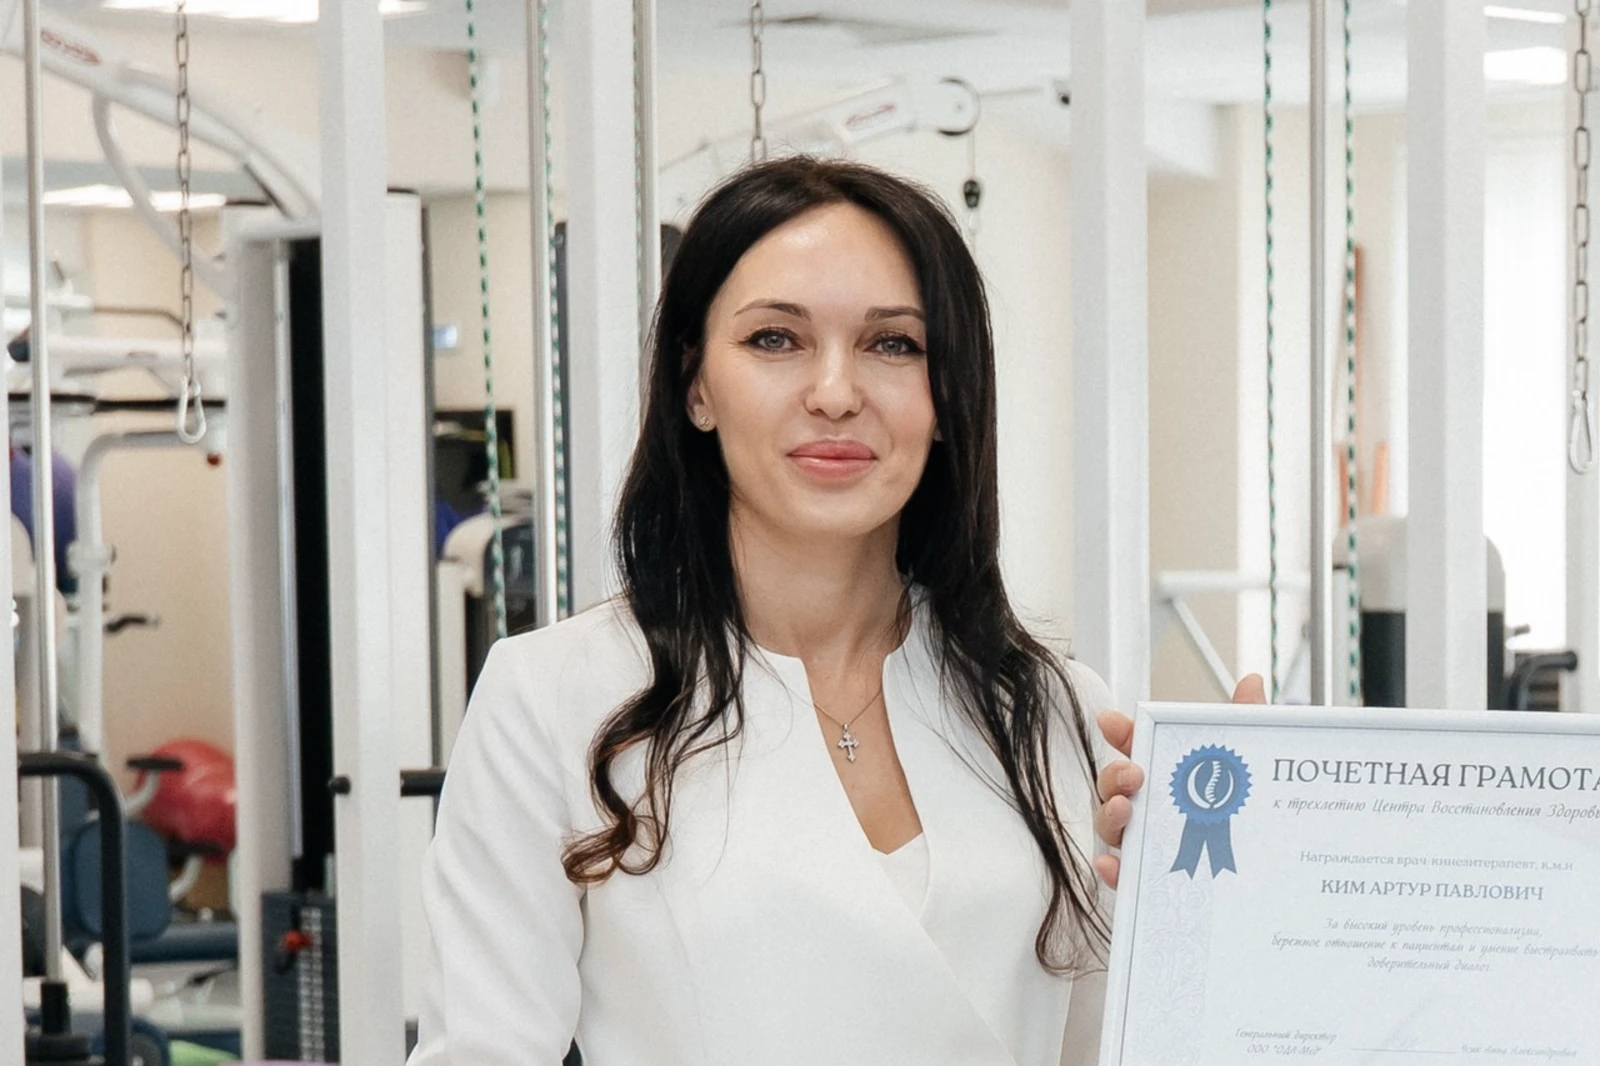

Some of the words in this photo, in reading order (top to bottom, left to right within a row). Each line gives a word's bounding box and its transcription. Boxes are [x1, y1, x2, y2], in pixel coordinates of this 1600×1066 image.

[1272, 758, 1451, 787] ПОЧЕТНАЯ
[1273, 799, 1281, 810] к
[1287, 798, 1366, 815] трехлетию
[1372, 799, 1425, 818] Центра
[1431, 801, 1541, 818] Восстановления
[1300, 851, 1394, 866] Награждается
[1320, 879, 1366, 894] КИМ
[1369, 881, 1432, 897] АРТУР
[1435, 883, 1544, 901] ПАВЛОВИЧ
[1324, 917, 1339, 929] За
[1343, 918, 1388, 931] высокий
[1391, 920, 1434, 936] уровень
[1271, 931, 1320, 950] бережное
[1324, 938, 1386, 950] отношение
[1402, 941, 1464, 953] пациентам
[1480, 945, 1519, 959] умение
[1523, 943, 1598, 960] выстраивать
[1367, 956, 1449, 973] доверительный
